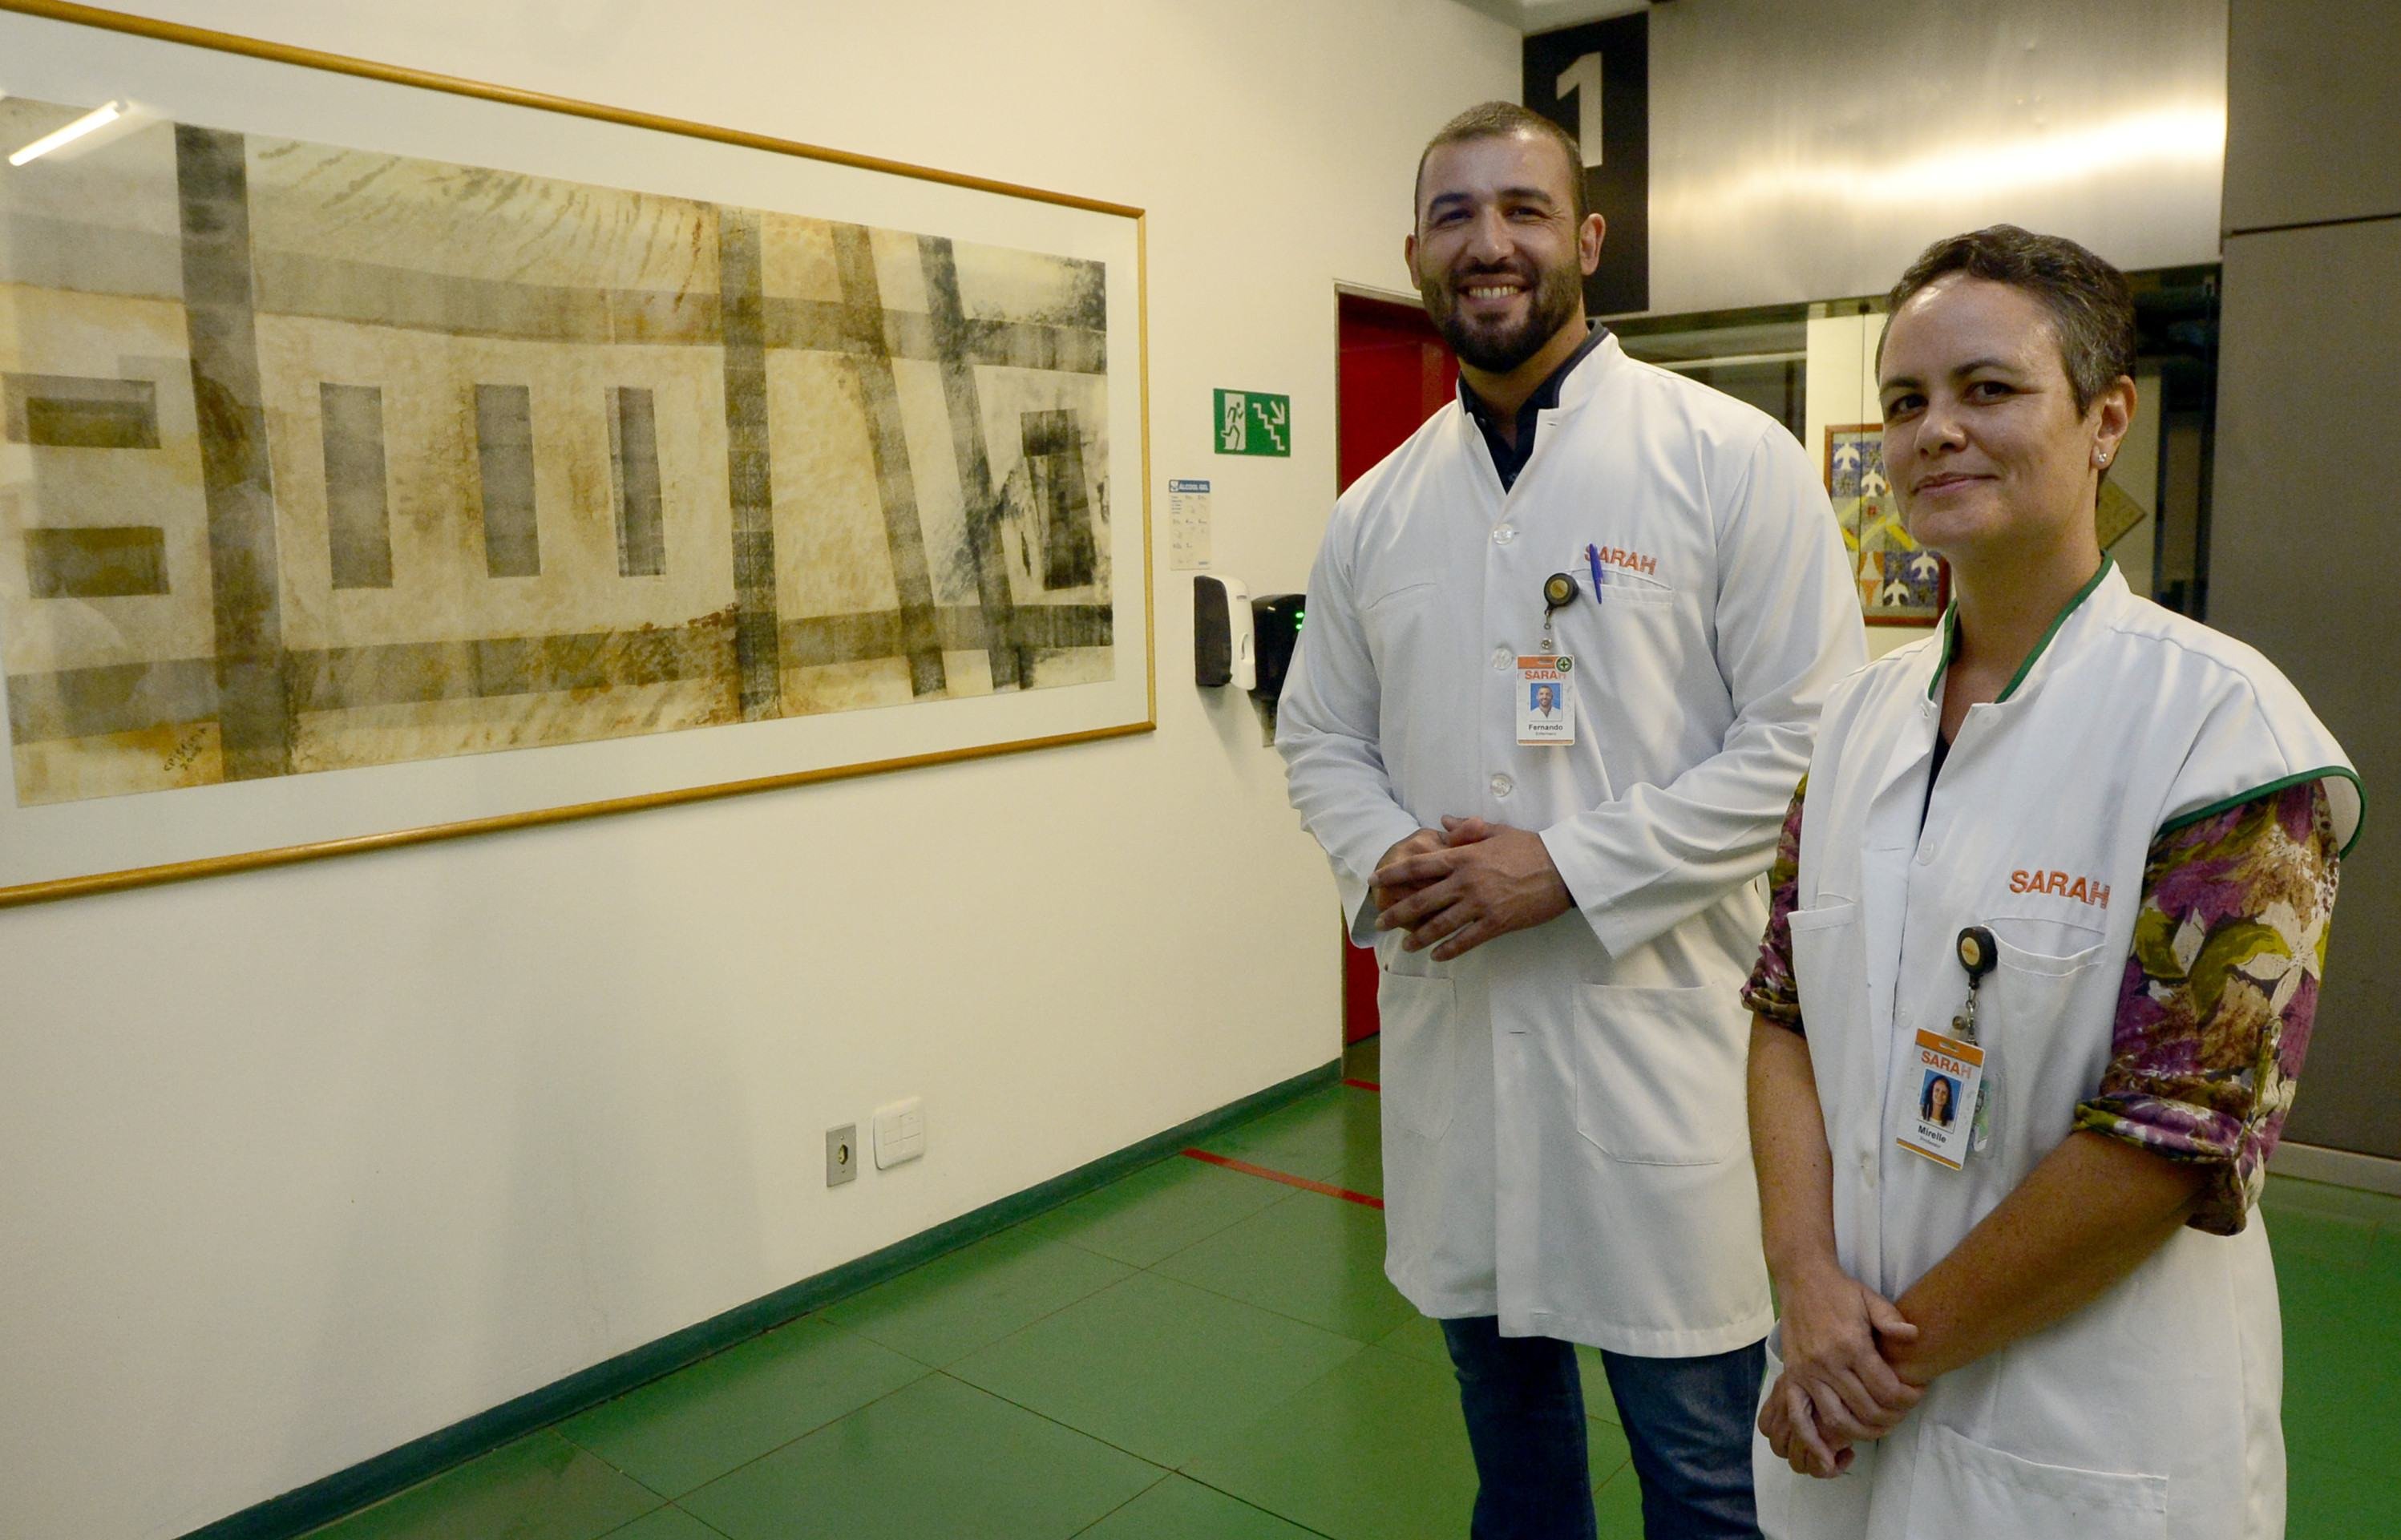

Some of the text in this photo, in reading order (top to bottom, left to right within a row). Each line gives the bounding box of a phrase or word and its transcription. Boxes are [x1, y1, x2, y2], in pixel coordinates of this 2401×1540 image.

[1556, 51, 1603, 168] 1
[2009, 869, 2111, 910] SARAH
[1921, 1049, 1973, 1079] SARAH
[1918, 1125, 1946, 1143] Mirelle
